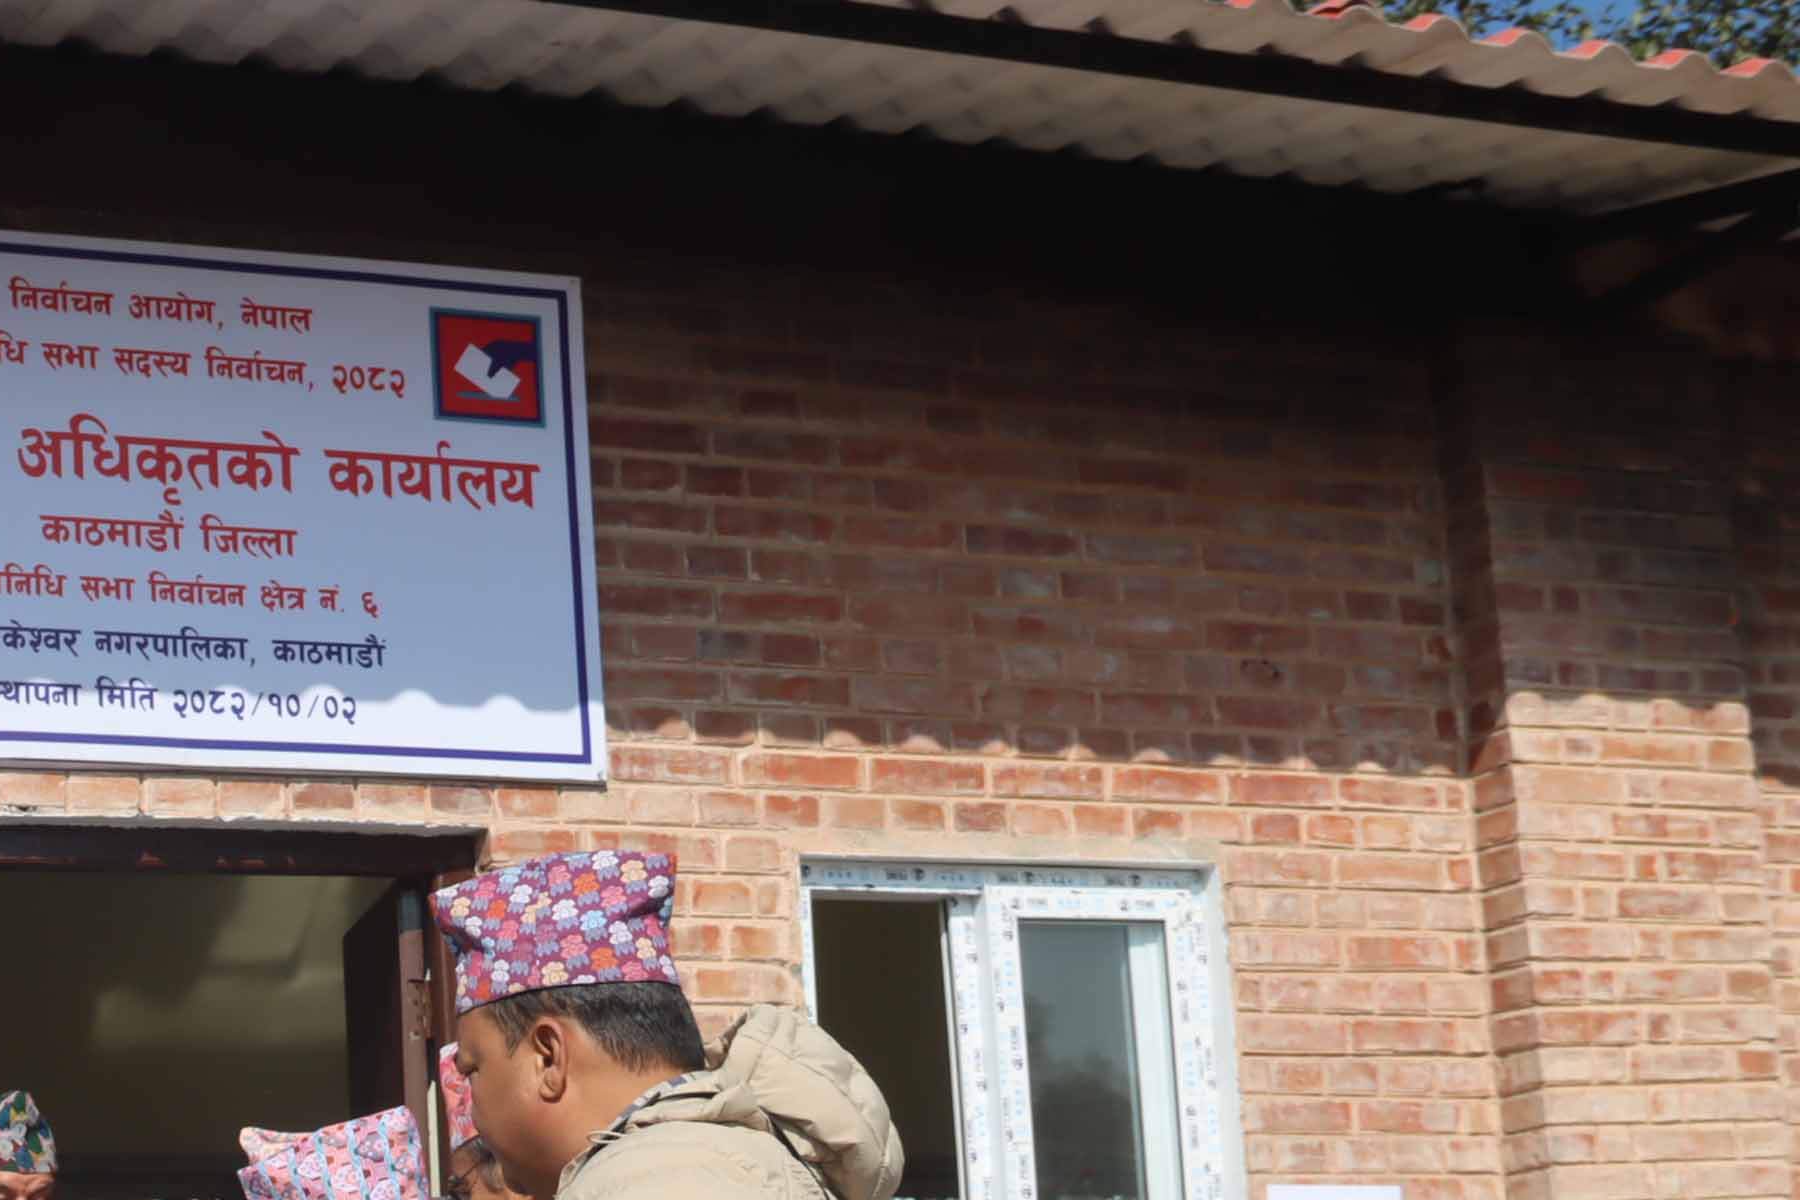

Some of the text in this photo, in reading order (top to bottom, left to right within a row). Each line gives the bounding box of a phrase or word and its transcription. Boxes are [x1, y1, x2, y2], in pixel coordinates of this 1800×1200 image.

[9, 276, 312, 332] निर्वाचन आयोग, नेपाल
[42, 342, 98, 370] सभा
[113, 347, 190, 377] सदस्य
[205, 345, 313, 390] निर्वाचन,
[333, 363, 405, 398] २०८२
[18, 414, 298, 505] अधिकृतको
[324, 440, 540, 510] कार्यालय
[40, 510, 297, 558] काठमाडौं जिल्ला
[80, 575, 134, 601] सभा
[149, 571, 245, 607] निर्वाचन
[260, 581, 305, 610] क्षेत्र
[319, 584, 344, 613] नं.
[362, 592, 378, 617] ६
[94, 626, 256, 668] नगरपालिका,
[273, 635, 386, 668] काठमाडौं
[96, 677, 158, 710] मिति
